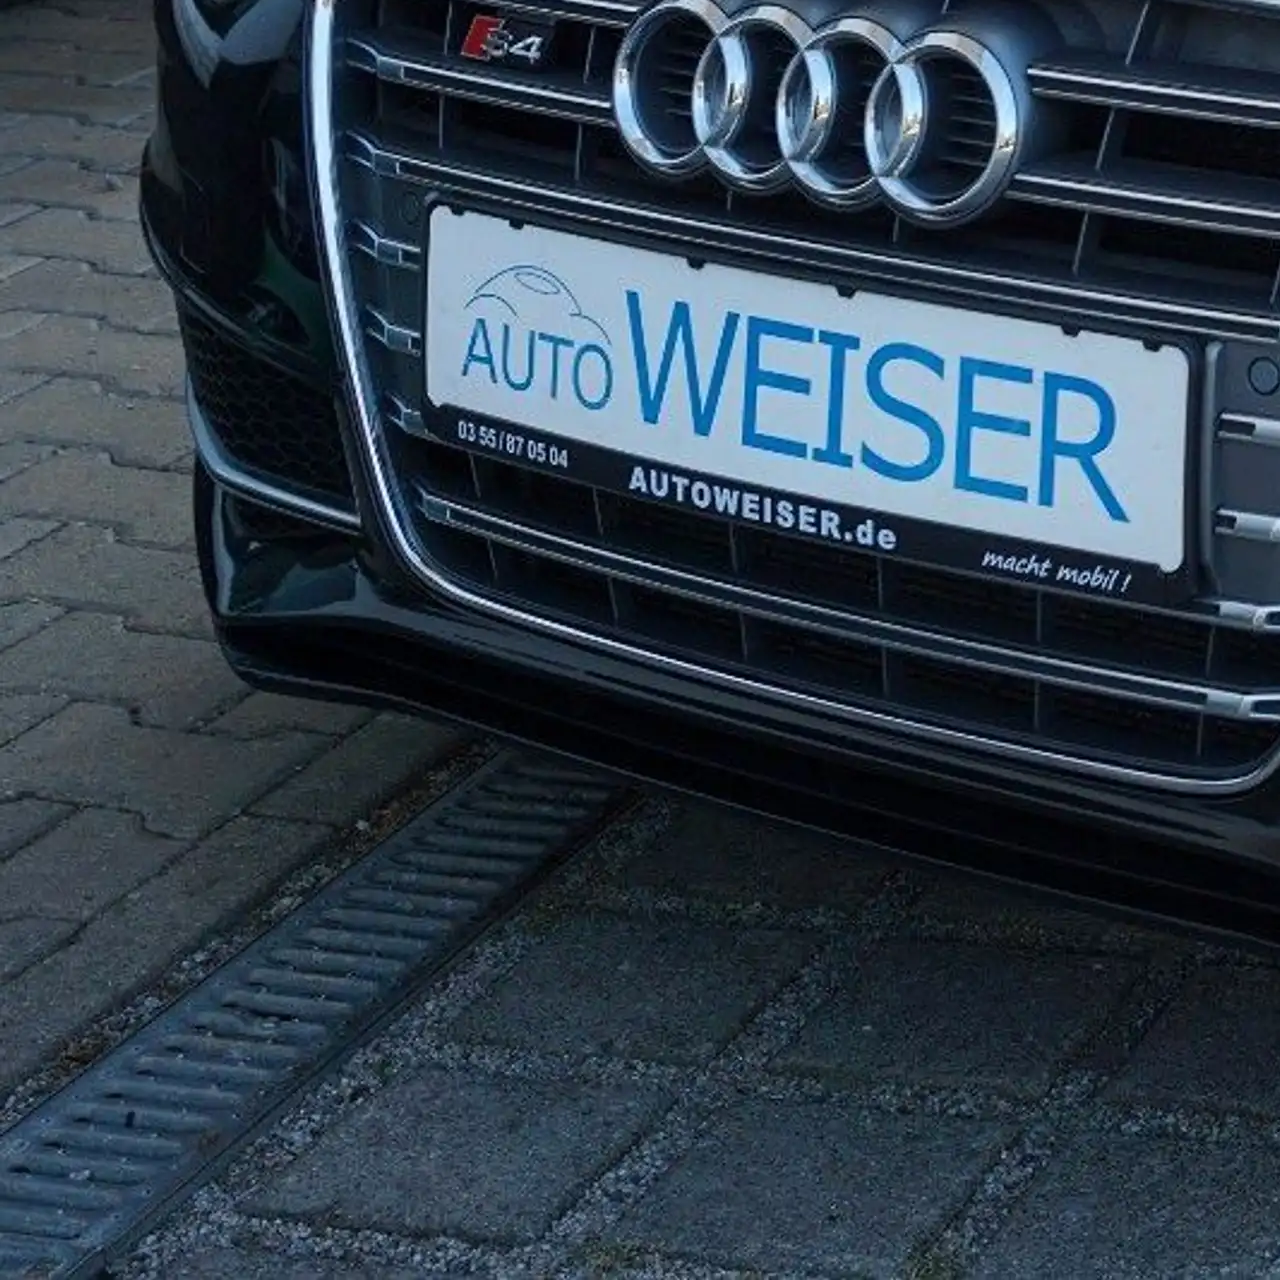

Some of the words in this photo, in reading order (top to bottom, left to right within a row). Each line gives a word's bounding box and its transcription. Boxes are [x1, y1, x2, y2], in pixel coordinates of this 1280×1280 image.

[478, 24, 543, 65] S4
[461, 316, 614, 411] AUTO
[624, 288, 1131, 524] WEISER
[458, 420, 477, 442] 03
[527, 439, 546, 463] 05
[548, 443, 568, 469] 04
[628, 465, 898, 551] AUTOWEISER.de
[981, 550, 1052, 578] macht
